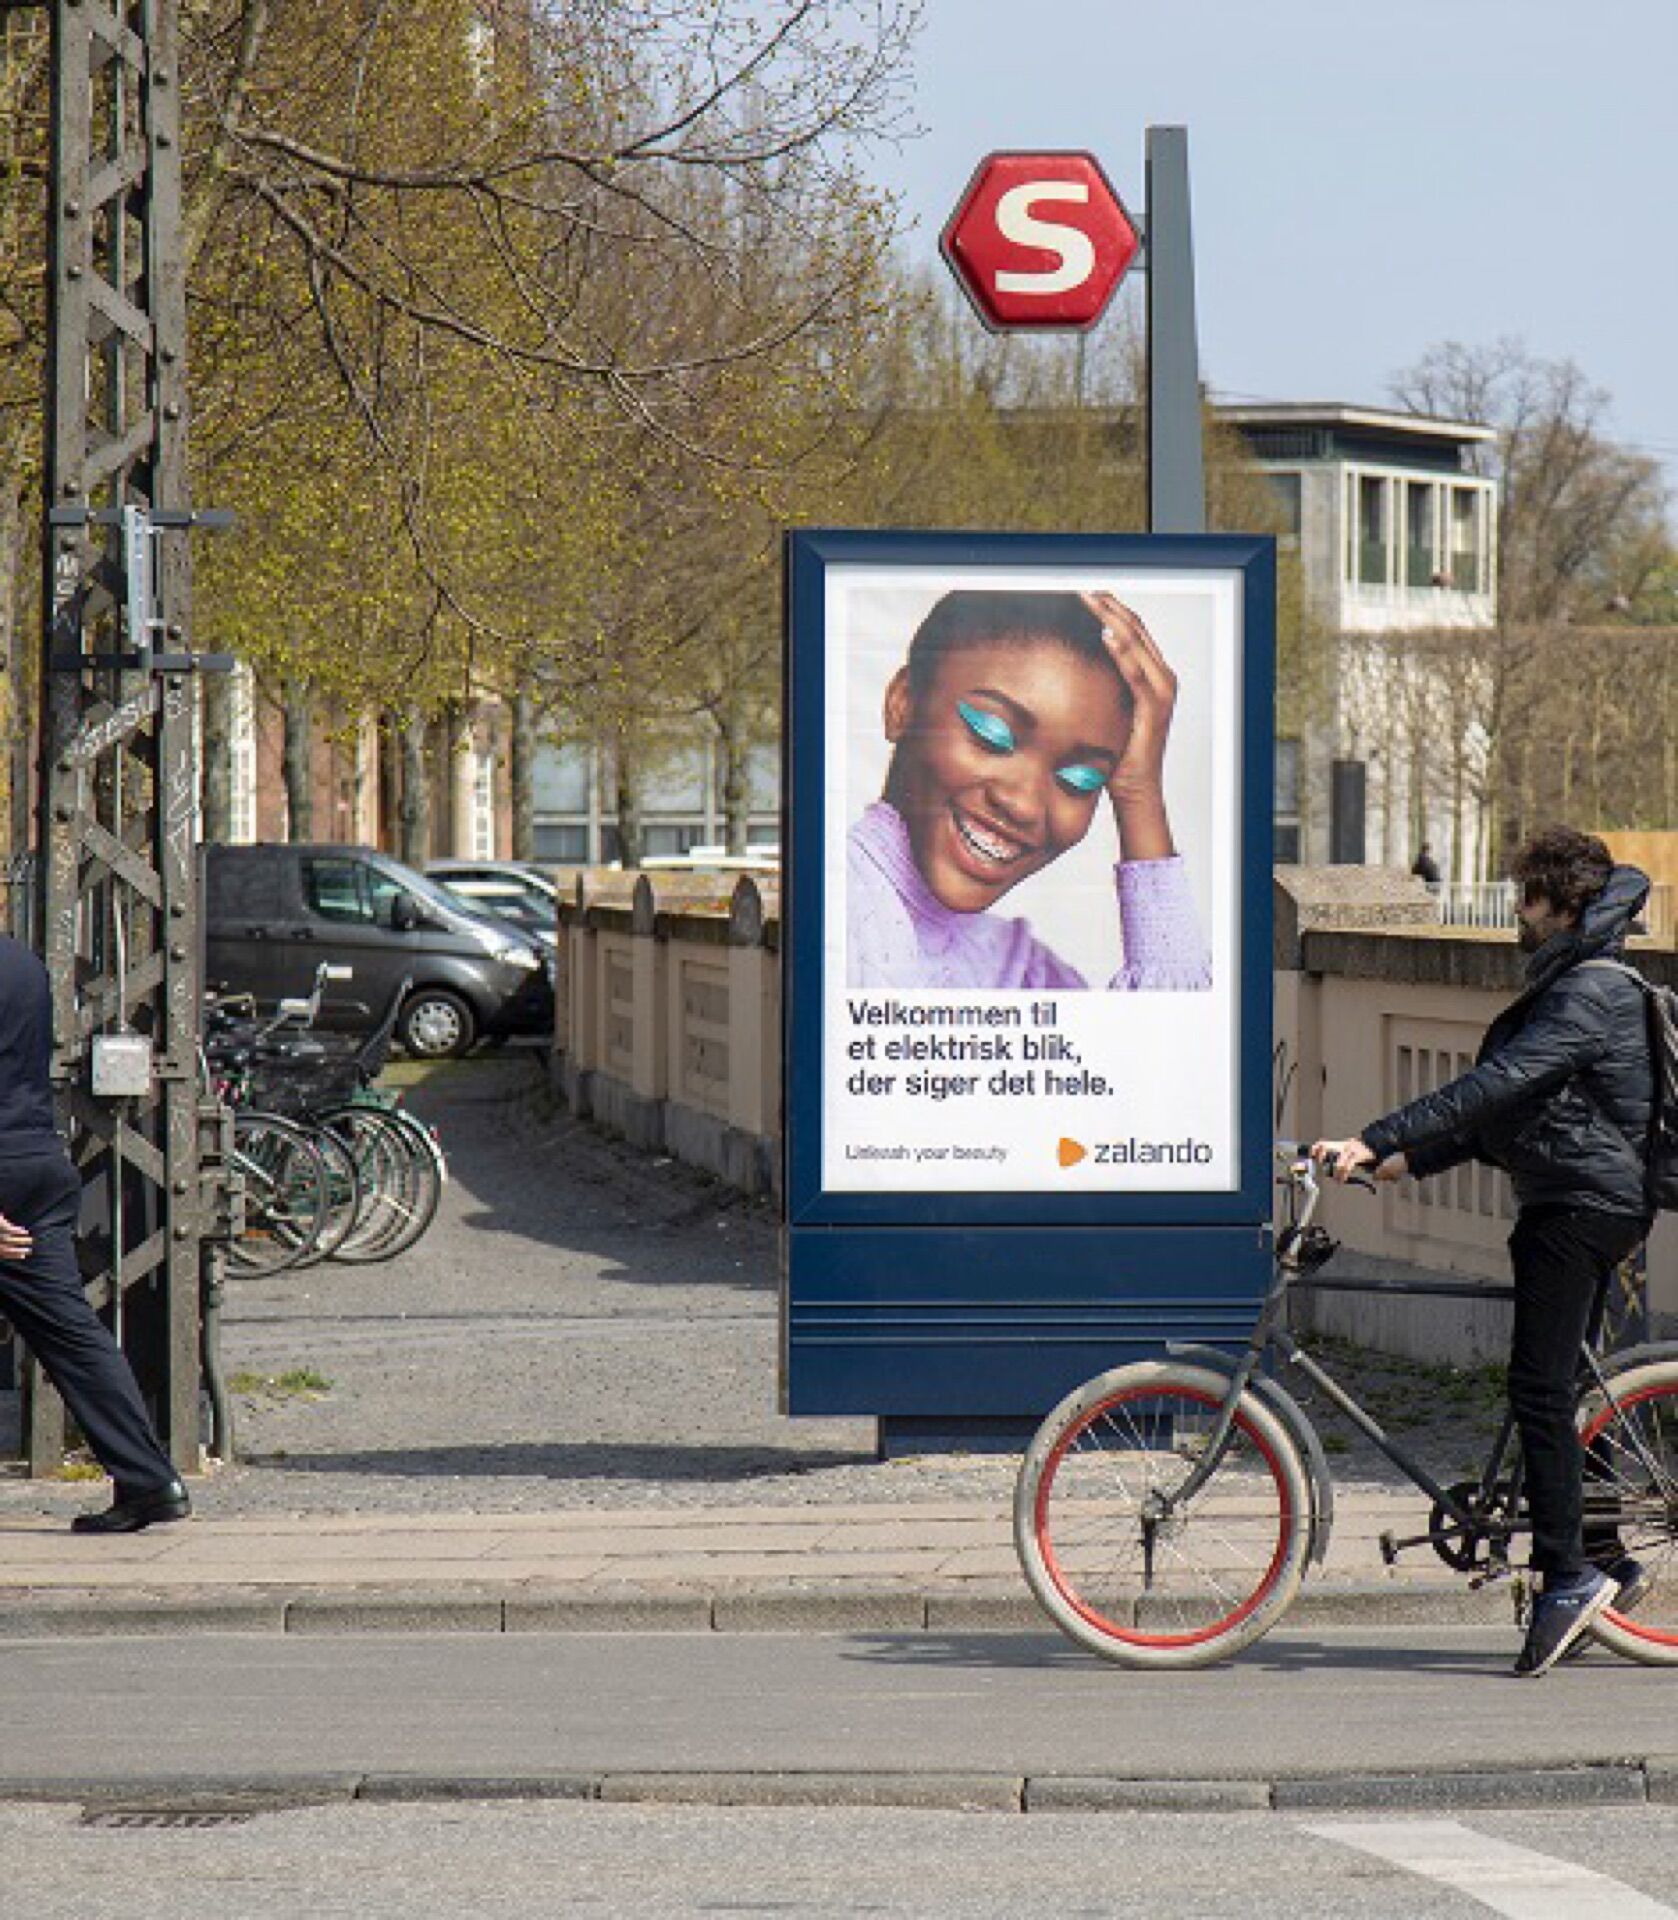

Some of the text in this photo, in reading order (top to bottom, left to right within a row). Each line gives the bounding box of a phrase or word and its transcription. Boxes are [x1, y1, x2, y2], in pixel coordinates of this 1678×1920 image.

[995, 181, 1096, 295] S
[847, 1000, 1057, 1027] Velkommen til
[847, 1034, 1082, 1064] et elektrisk blik,
[846, 1069, 1114, 1101] der siger det hele.
[1094, 1137, 1213, 1165] zalando
